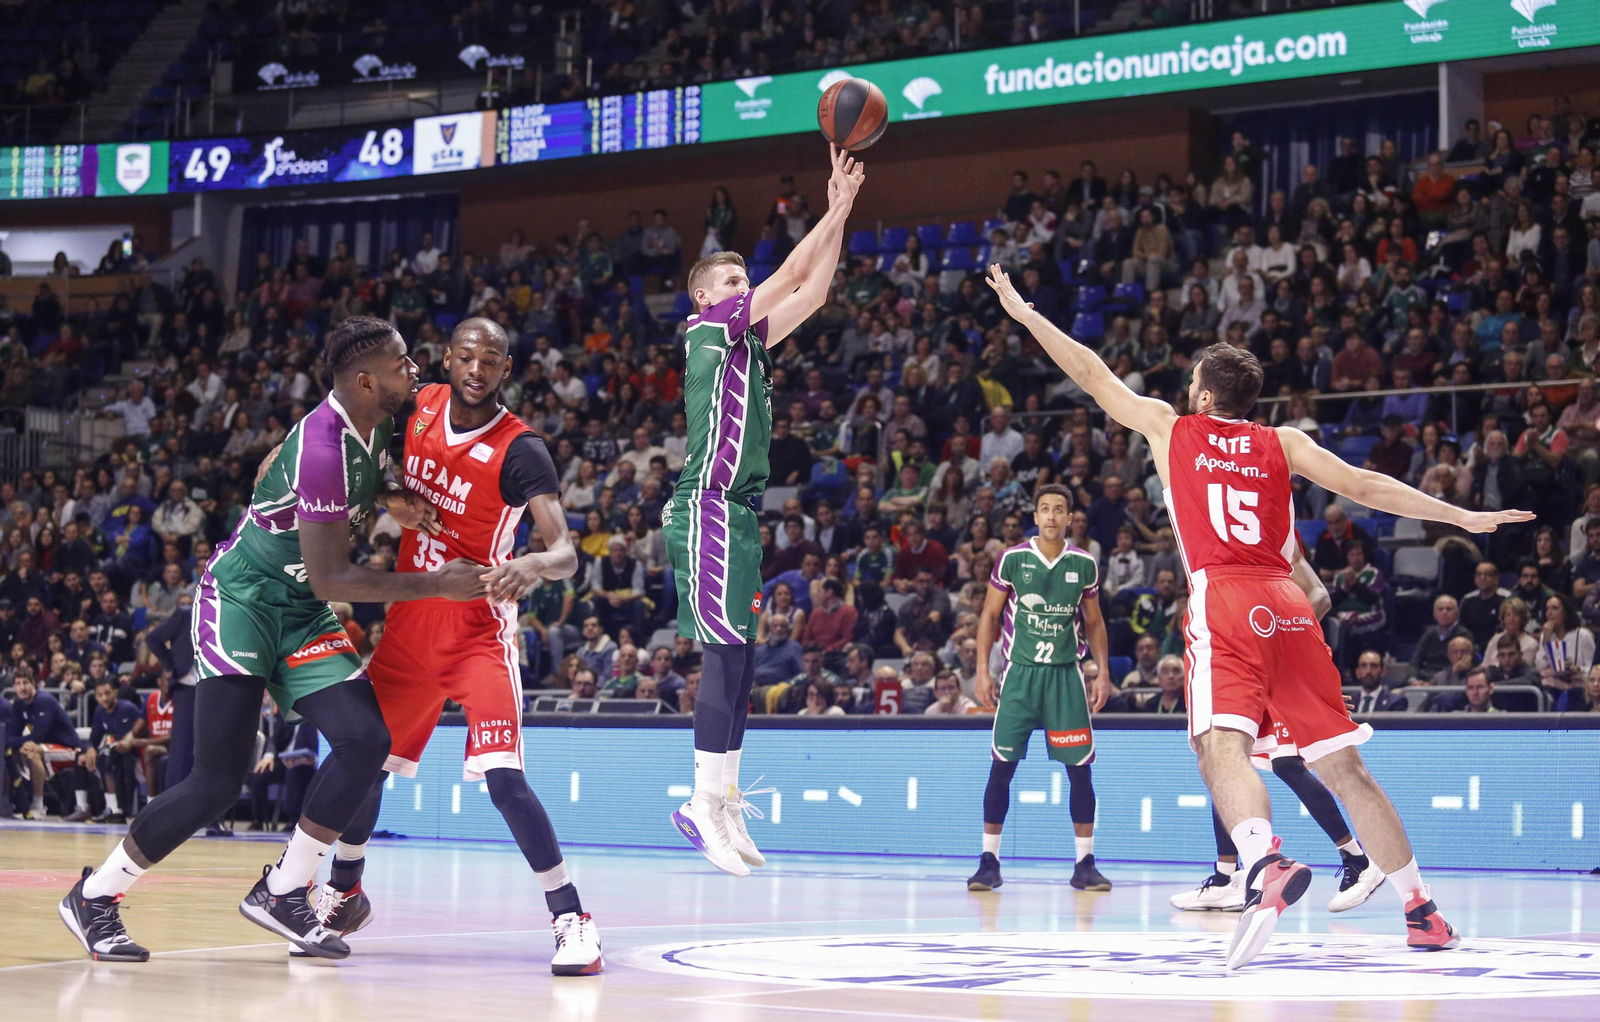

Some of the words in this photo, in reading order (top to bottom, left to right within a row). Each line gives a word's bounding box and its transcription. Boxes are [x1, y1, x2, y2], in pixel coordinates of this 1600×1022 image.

[985, 31, 1347, 95] fundacionunicaja.com
[358, 128, 403, 166] 48
[184, 146, 231, 183] 49
[405, 455, 473, 502] UCAM
[1207, 483, 1262, 545] 15
[413, 531, 447, 573] 35
[1044, 604, 1075, 615] Unicaja
[232, 650, 258, 659] SPALDING
[292, 638, 352, 659] worten
[1033, 641, 1054, 664] 22
[879, 689, 898, 715] 5
[481, 719, 512, 728] GLOBAL
[1050, 733, 1087, 744] worten
